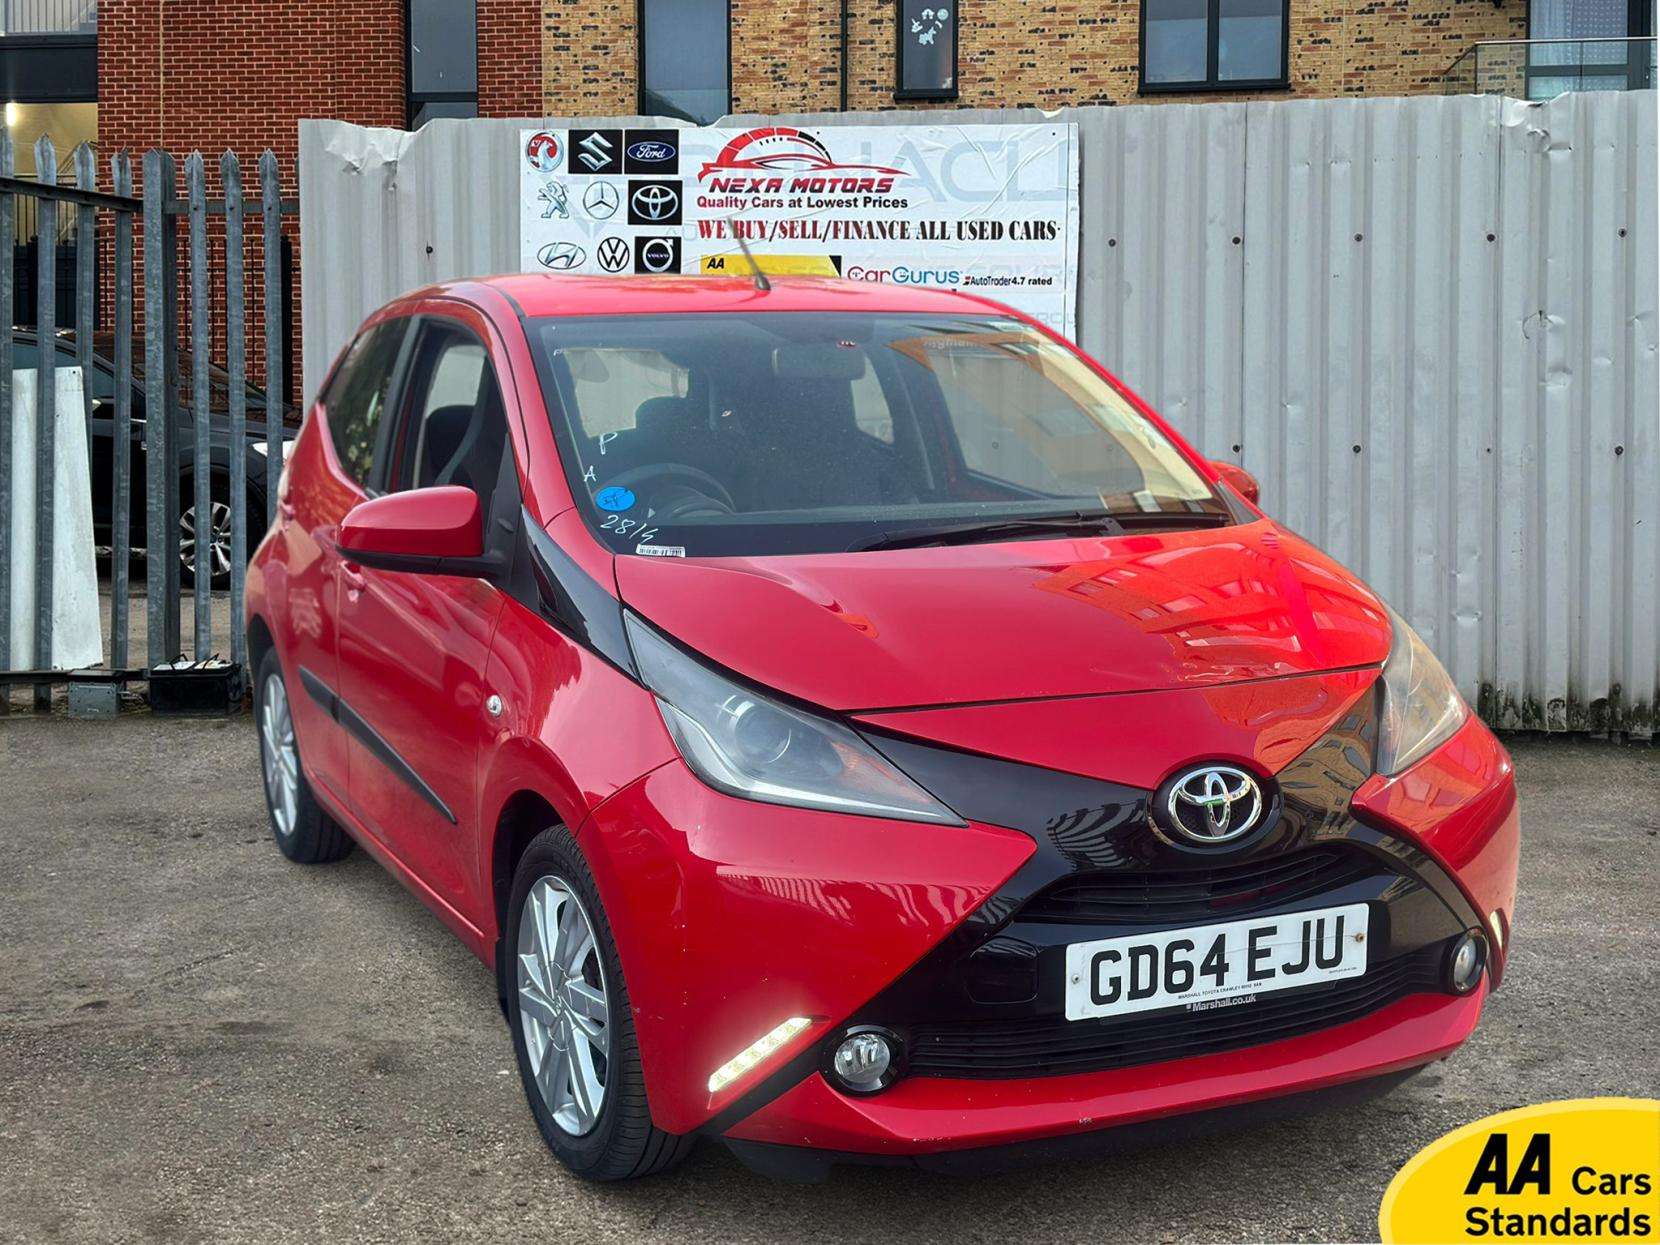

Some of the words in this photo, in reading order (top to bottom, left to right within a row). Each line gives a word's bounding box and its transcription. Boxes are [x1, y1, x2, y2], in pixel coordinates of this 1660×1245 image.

[636, 143, 666, 158] Ford
[709, 178, 784, 193] NEXA
[789, 178, 894, 193] MOTORS
[697, 196, 747, 210] Quality
[752, 196, 784, 208] Cars
[788, 197, 802, 208] at
[807, 196, 858, 208] Lowest
[863, 196, 908, 208] Prices
[697, 220, 727, 239] WE
[916, 221, 951, 240] ALL
[956, 221, 1004, 241] USED
[706, 258, 725, 269] AA
[1028, 277, 1052, 285] rated
[1090, 933, 1230, 1006] GD64
[1247, 915, 1346, 982] EJU
[1192, 994, 1257, 1012] Marshall.co.uk
